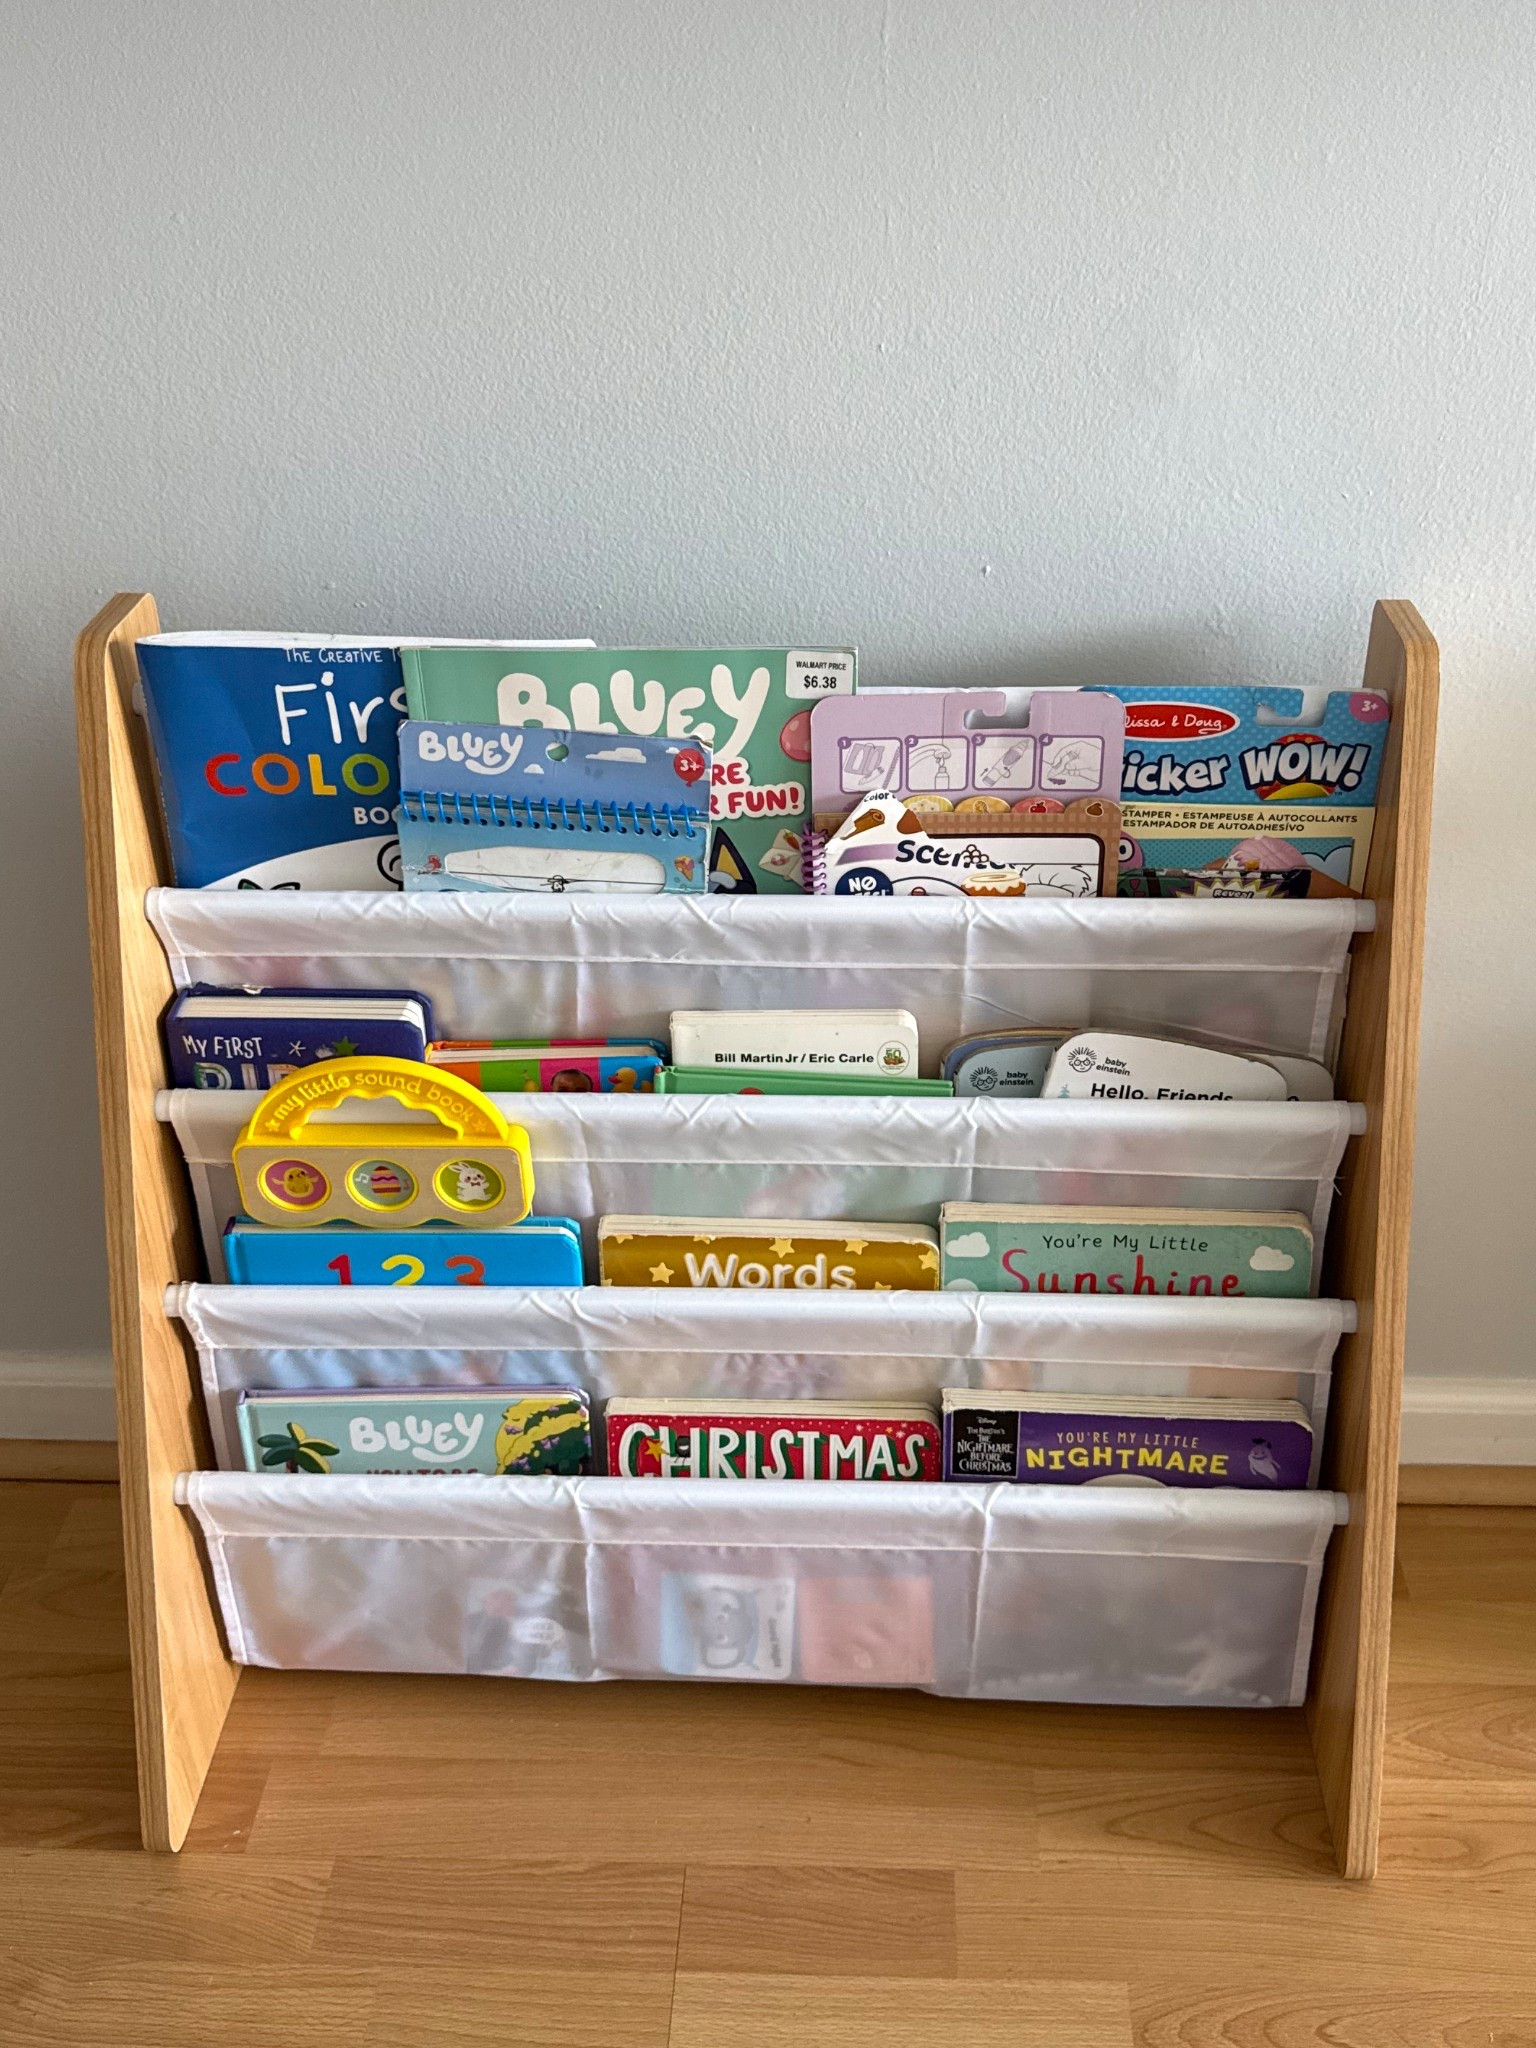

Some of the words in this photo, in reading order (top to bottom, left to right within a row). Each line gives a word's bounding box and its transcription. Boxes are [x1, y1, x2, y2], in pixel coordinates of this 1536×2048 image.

[796, 661, 828, 669] WALMART
[804, 674, 837, 689] $6.38
[497, 664, 771, 757] BLUEY
[1361, 700, 1378, 712] 3+
[1184, 714, 1222, 734] Doug
[975, 736, 982, 744] 3
[419, 730, 524, 775] BLUEY
[680, 759, 701, 771] 3+
[1122, 751, 1230, 795] icker
[1241, 741, 1370, 790] WOW!
[728, 787, 799, 814] FUN!
[1122, 810, 1171, 819] STAMPER
[1183, 811, 1254, 821] ESTAMPEUSE
[1257, 812, 1265, 821] À
[1268, 813, 1358, 823] AUTOCOLLANTS
[1123, 820, 1196, 829] ESTAMPADOR
[1217, 822, 1304, 832] AUTOADHESÍVO
[182, 1035, 207, 1058] MY
[213, 1036, 262, 1059] FIRST
[714, 1053, 735, 1063] Bill
[740, 1053, 783, 1063] Martin
[785, 1053, 798, 1063] Jr
[800, 1053, 806, 1063] /
[809, 1053, 835, 1063] Eric
[839, 1053, 874, 1063] Carle
[1104, 1057, 1127, 1068] baby
[1096, 1064, 1130, 1076] einstein
[999, 1078, 1034, 1086] einstein
[273, 1093, 305, 1121] my
[301, 1073, 350, 1101] little
[354, 1072, 422, 1096] sound
[427, 1085, 474, 1122] book
[1042, 1234, 1102, 1249] You're
[1113, 1235, 1139, 1252] My
[1150, 1236, 1208, 1252] Little
[327, 1253, 352, 1286] 1
[381, 1254, 425, 1286] 2
[684, 1252, 857, 1289] Words
[1002, 1248, 1245, 1296] Sunshine
[349, 1412, 484, 1463] BLUEY
[957, 1439, 1014, 1454] NIGHTMARE
[1056, 1431, 1109, 1445] YOU'RE
[1117, 1432, 1136, 1444] MY
[1144, 1434, 1199, 1449] LITTLE
[618, 1422, 926, 1480] CHRISTMAS
[970, 1452, 1003, 1462] BEFORE
[959, 1458, 1012, 1472] CHRISTMAS
[1025, 1446, 1229, 1475] NIGHTMARE
